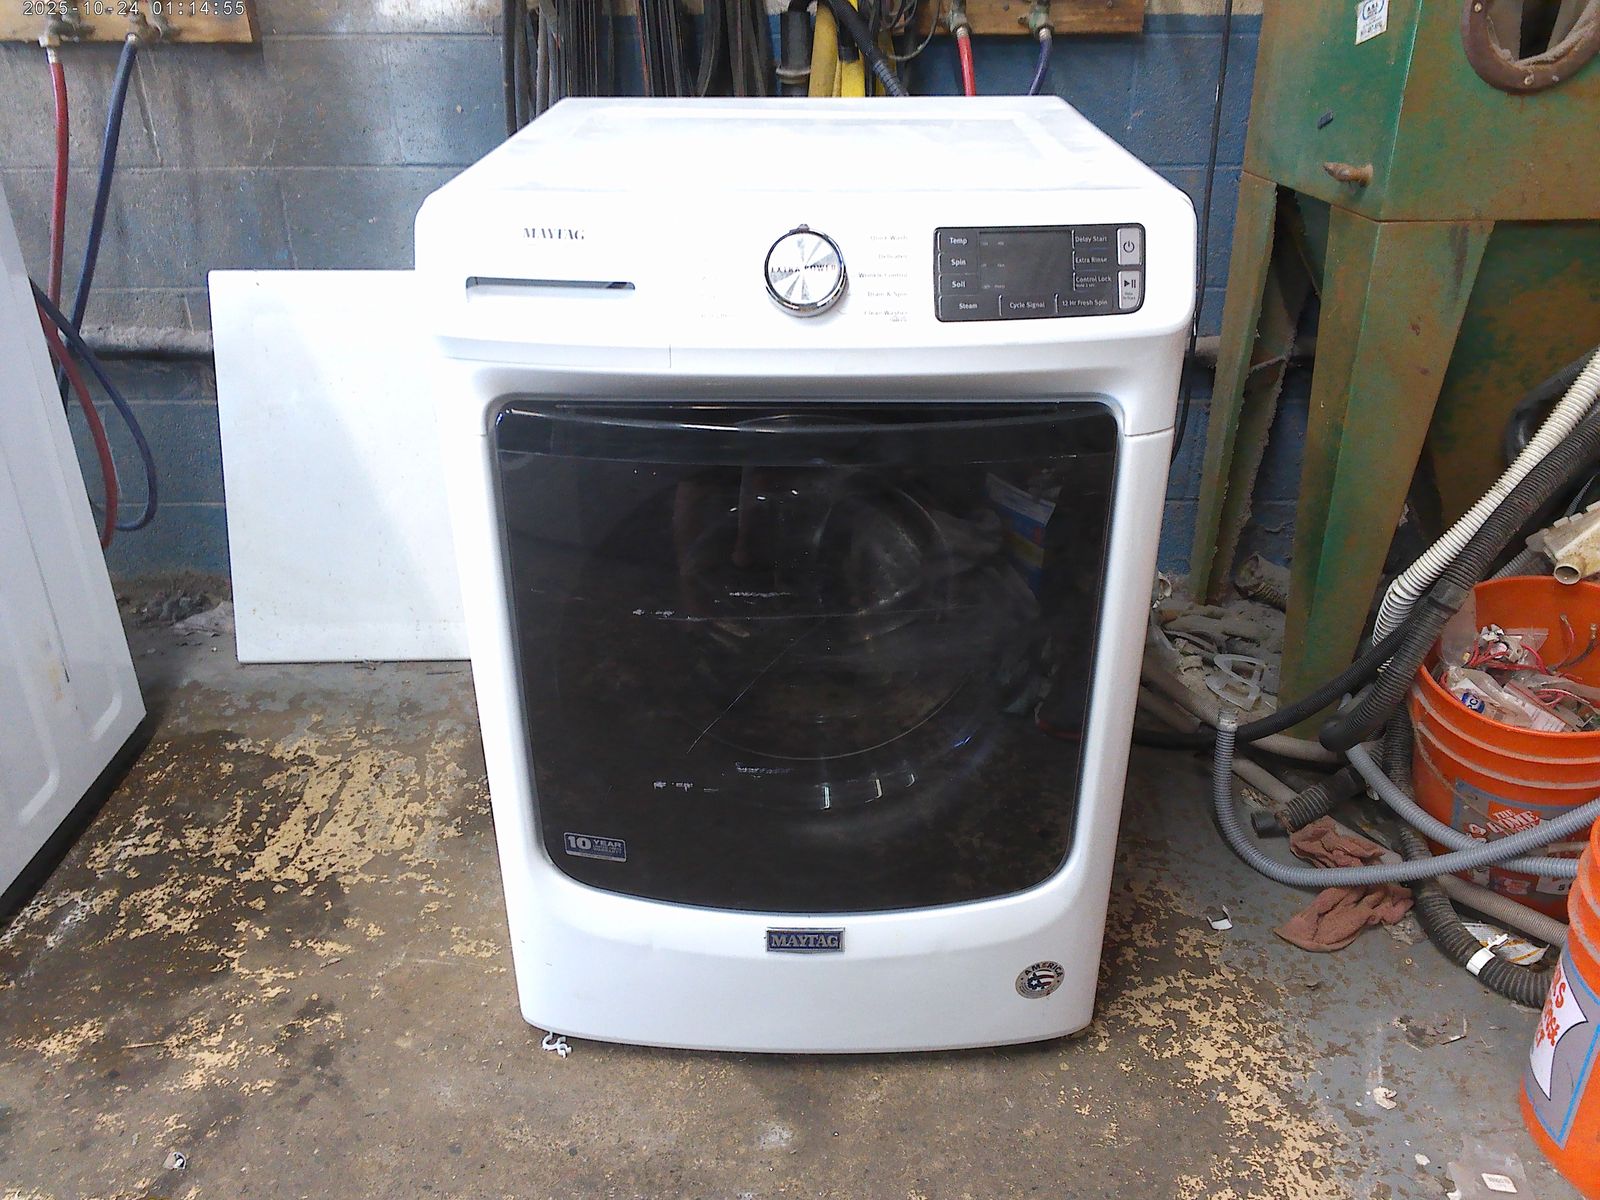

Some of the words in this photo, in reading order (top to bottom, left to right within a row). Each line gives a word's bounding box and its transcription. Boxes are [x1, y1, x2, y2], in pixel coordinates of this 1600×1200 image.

[523, 227, 585, 240] MAYTAG
[949, 237, 968, 246] Temp
[951, 258, 966, 267] Spin
[951, 280, 966, 288] Soil
[959, 302, 978, 310] Steam
[1009, 301, 1024, 310] Cycle
[1026, 301, 1045, 310] Signal
[1094, 299, 1108, 307] Spin
[1492, 809, 1516, 820] THE
[567, 835, 592, 850] 10
[593, 839, 622, 848] YEAR
[771, 934, 839, 948] MAYTAG
[1024, 961, 1064, 978] AMERICA
